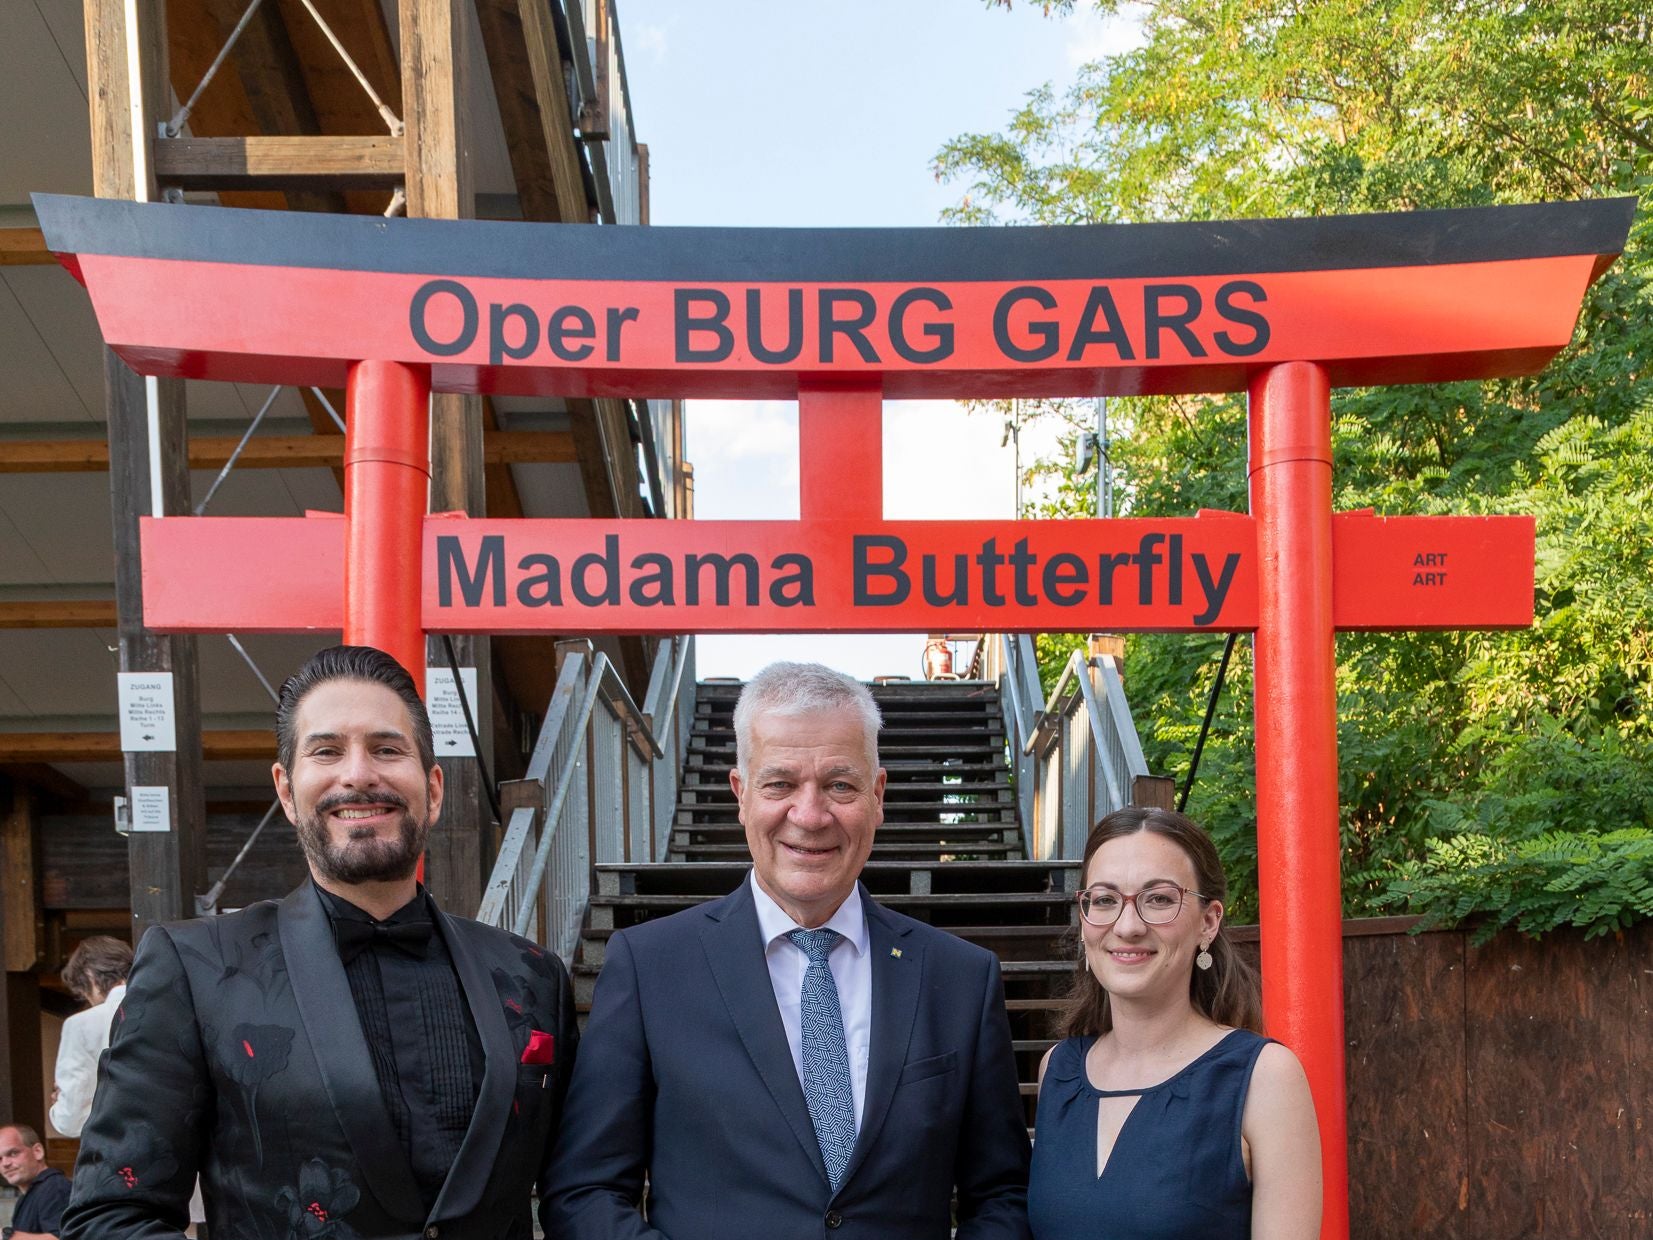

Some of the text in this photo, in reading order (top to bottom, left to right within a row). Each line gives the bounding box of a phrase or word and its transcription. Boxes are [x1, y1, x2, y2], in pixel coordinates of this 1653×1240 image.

[409, 279, 1272, 365] Oper BURG GARS
[437, 533, 1242, 627] Madama Butterfly
[1412, 573, 1448, 586] ART
[1413, 553, 1448, 567] ART
